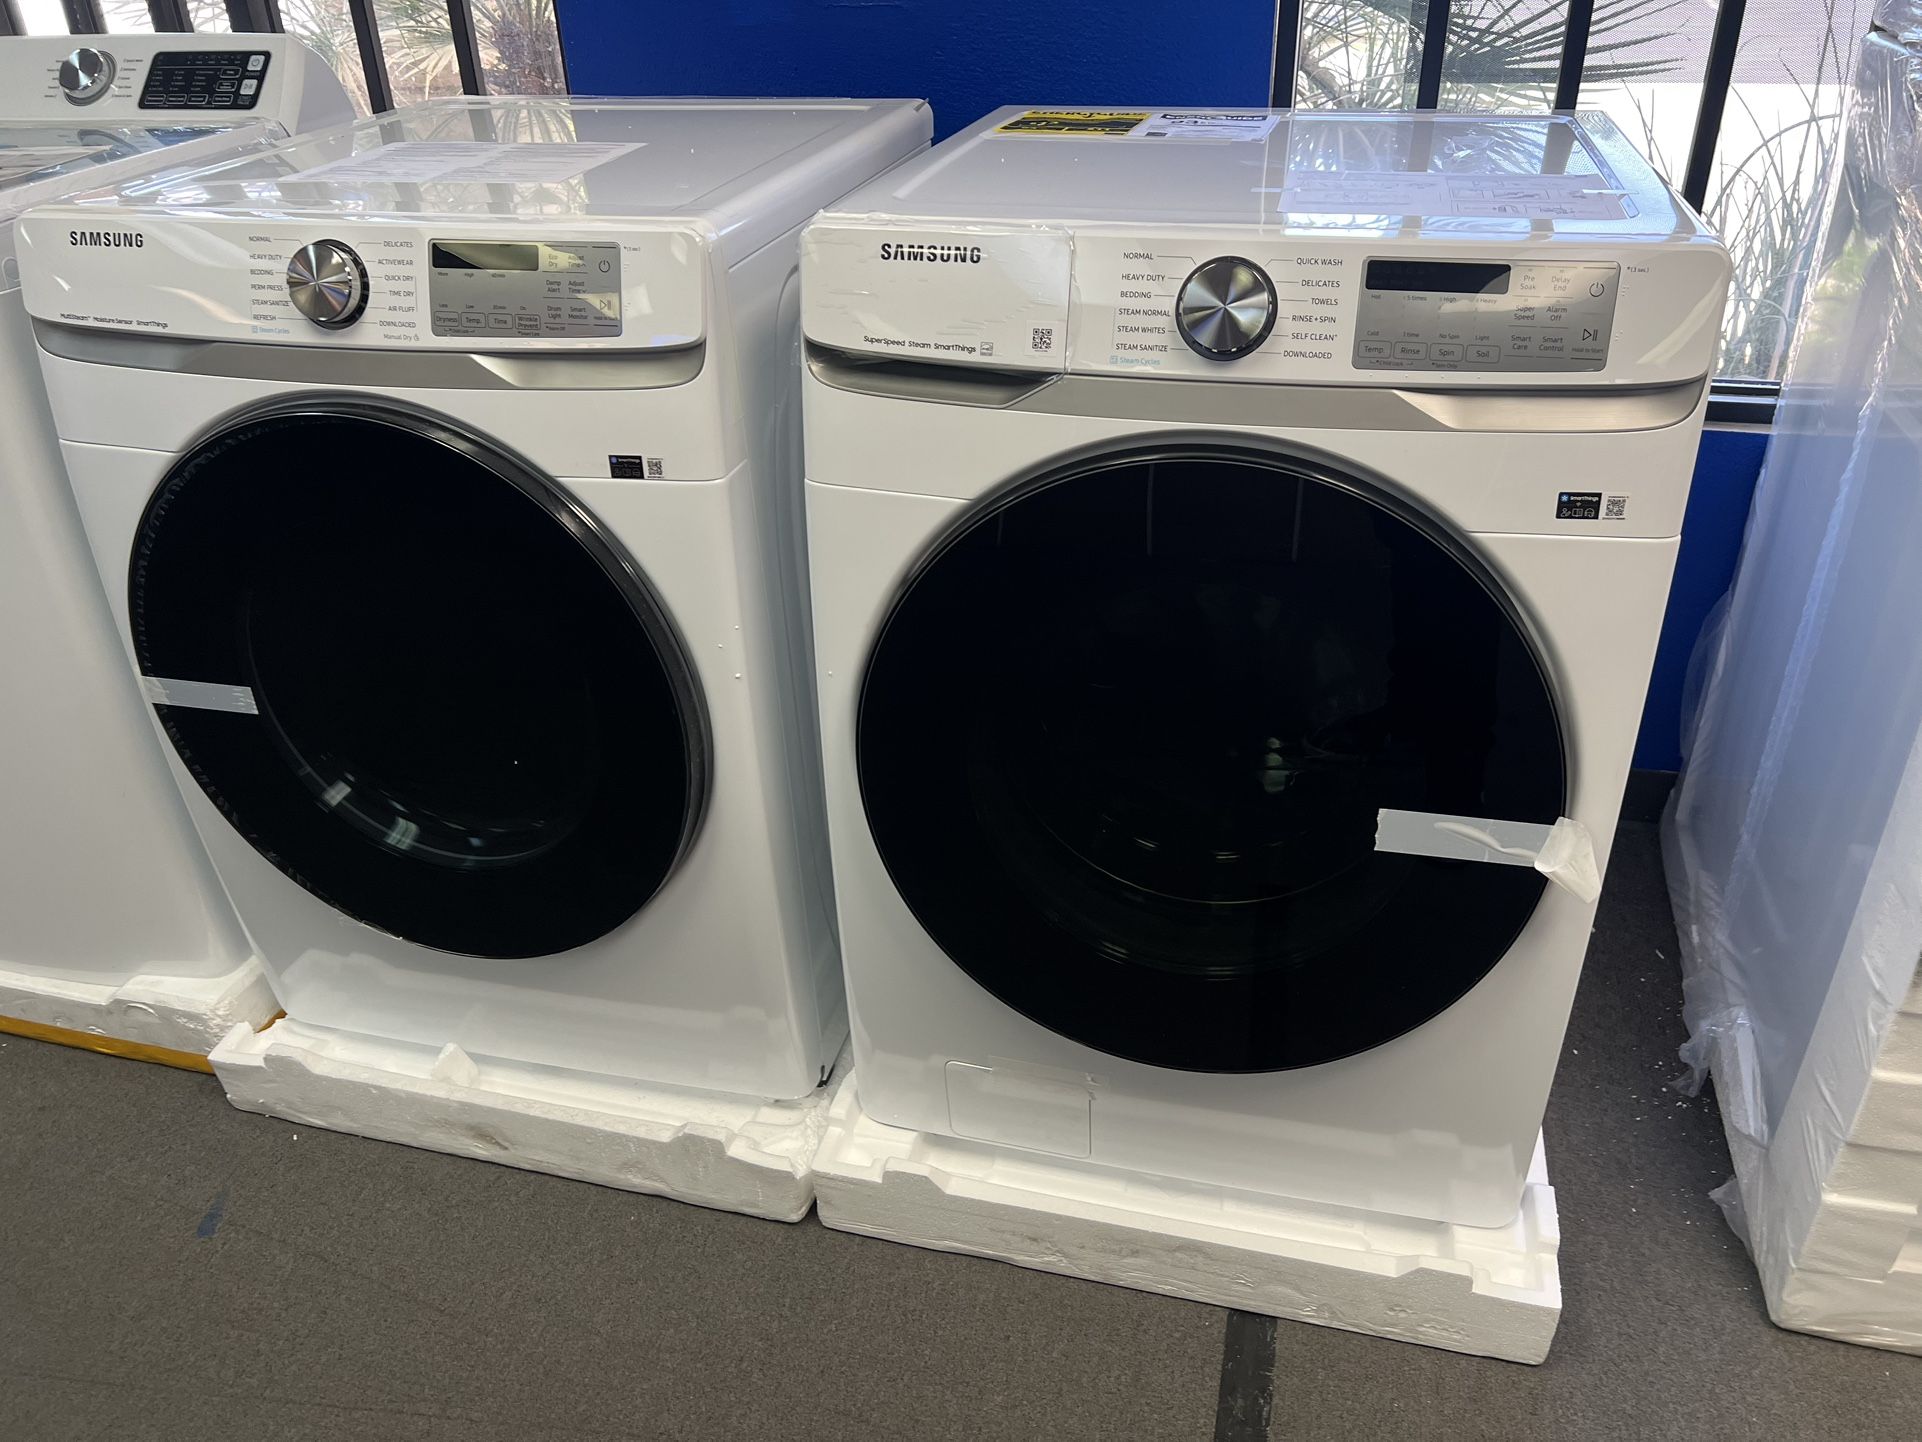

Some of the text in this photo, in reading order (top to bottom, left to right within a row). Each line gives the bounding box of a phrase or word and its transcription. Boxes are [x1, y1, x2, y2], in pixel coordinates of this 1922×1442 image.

[70, 230, 144, 248] SAMSUNG
[880, 243, 982, 264] SAMSUNG
[1296, 258, 1319, 266] QUICK
[1120, 290, 1152, 299] BEDDING
[1311, 298, 1338, 306] TOWELS
[1142, 309, 1171, 317] NORMAL
[1514, 313, 1535, 321] Speed
[436, 316, 458, 324] Dryness
[136, 320, 168, 329] SmartThings
[1141, 326, 1166, 334] WHITES
[403, 334, 412, 342] Dry
[864, 336, 906, 347] SuperSpeed
[934, 343, 976, 354] SmartThings
[1139, 344, 1168, 352] SANITIZE
[1538, 344, 1564, 352] Control
[1283, 350, 1332, 359] DOWNLOADED
[1438, 348, 1455, 357] Spin
[1140, 358, 1160, 366] Cycles
